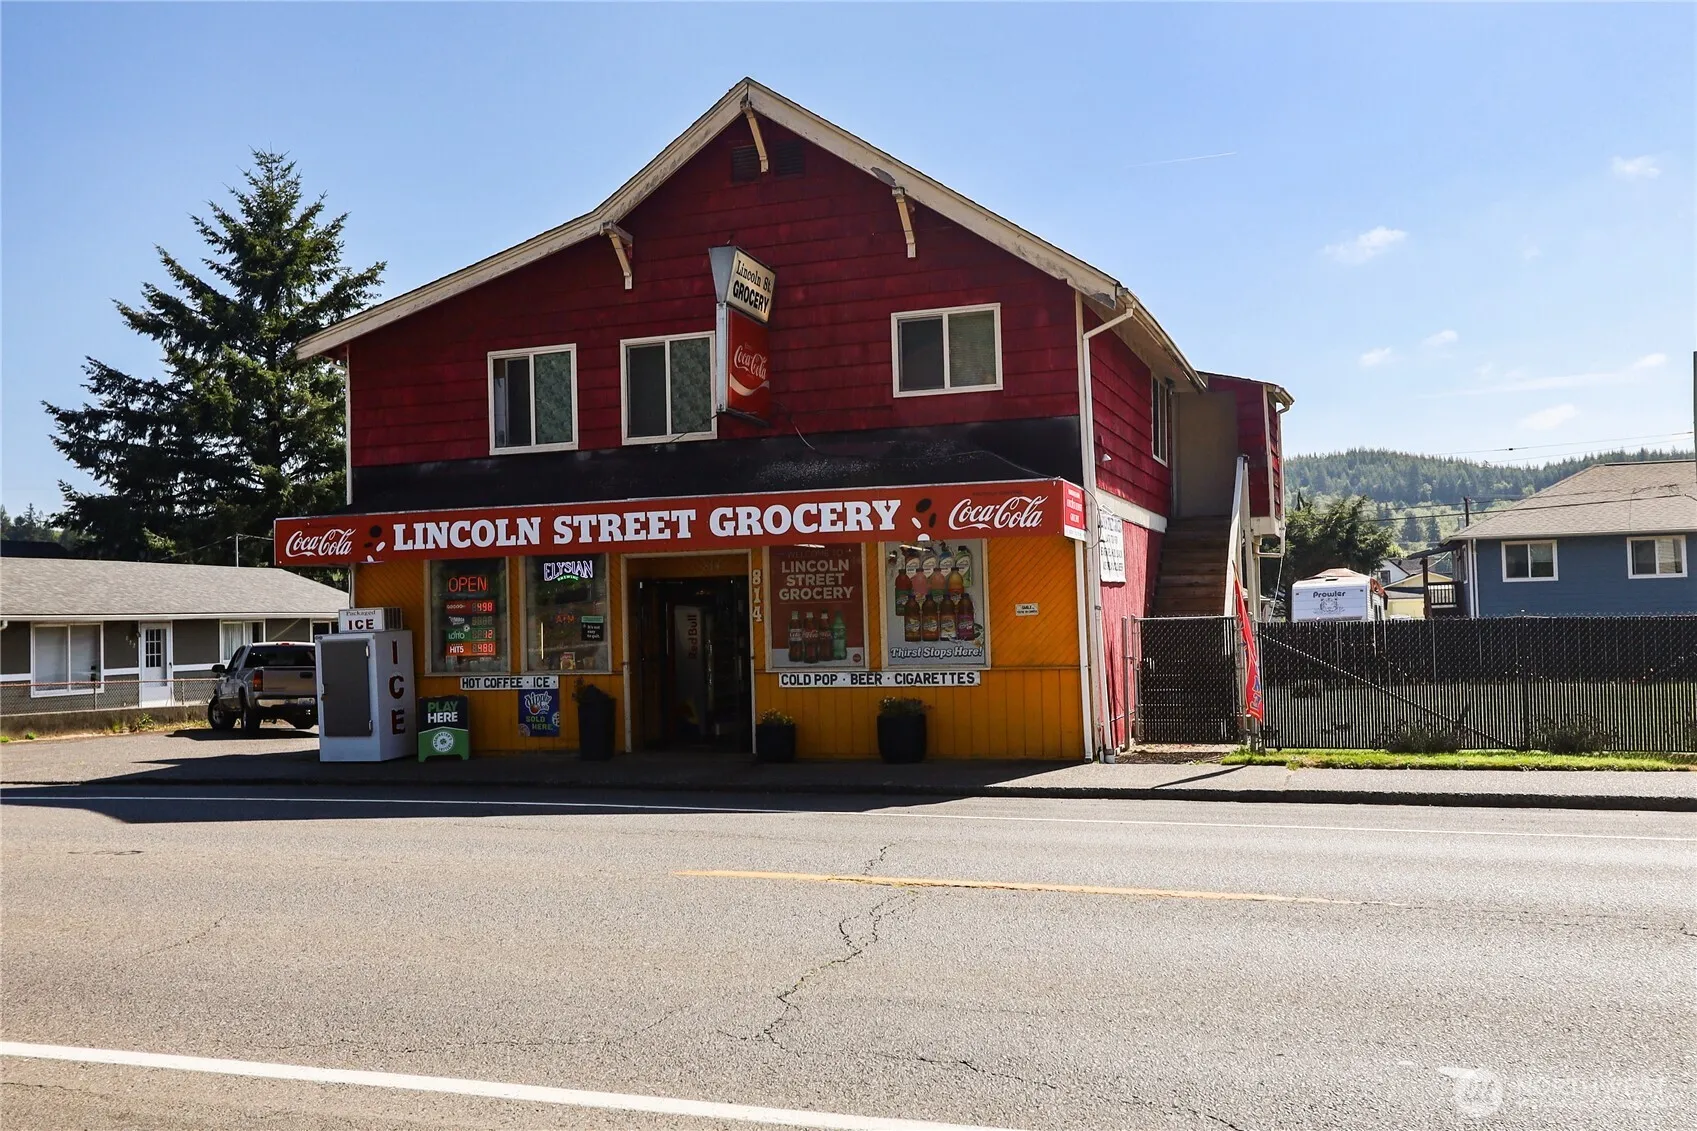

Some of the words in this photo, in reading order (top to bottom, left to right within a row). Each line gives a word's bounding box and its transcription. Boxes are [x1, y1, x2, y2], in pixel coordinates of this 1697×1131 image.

[736, 259, 762, 287] Lincoln
[762, 276, 772, 292] St.
[733, 280, 769, 314] GROCERY
[734, 345, 767, 380] Coca-Cola
[949, 496, 1048, 531] Coca-Cola
[393, 517, 541, 551] LINCOLN
[554, 509, 696, 545] STREET
[709, 500, 901, 537] GROCERY
[286, 528, 356, 557] Coca-Cola
[544, 560, 593, 581] ELYSIAN
[781, 559, 849, 573] LINCOLN
[448, 576, 487, 592] OPEN
[786, 573, 845, 586] STREET
[752, 569, 763, 622] 814
[779, 586, 854, 600] GROCERY
[348, 619, 374, 630] ICE
[891, 647, 920, 658] Thirst
[923, 647, 952, 659] Stops
[954, 646, 983, 657] Here!
[462, 678, 481, 689] HOT
[484, 677, 523, 689] COFFEE
[533, 677, 550, 688] ICE
[781, 673, 811, 686] COLD
[814, 673, 838, 686] POP
[850, 673, 883, 686] BEER
[895, 672, 975, 685] CIGARETTES
[389, 640, 406, 735] ICE
[428, 701, 458, 712] PLAY
[428, 711, 458, 723] HERE
[525, 715, 546, 723] SOLD
[532, 723, 553, 731] HERE
